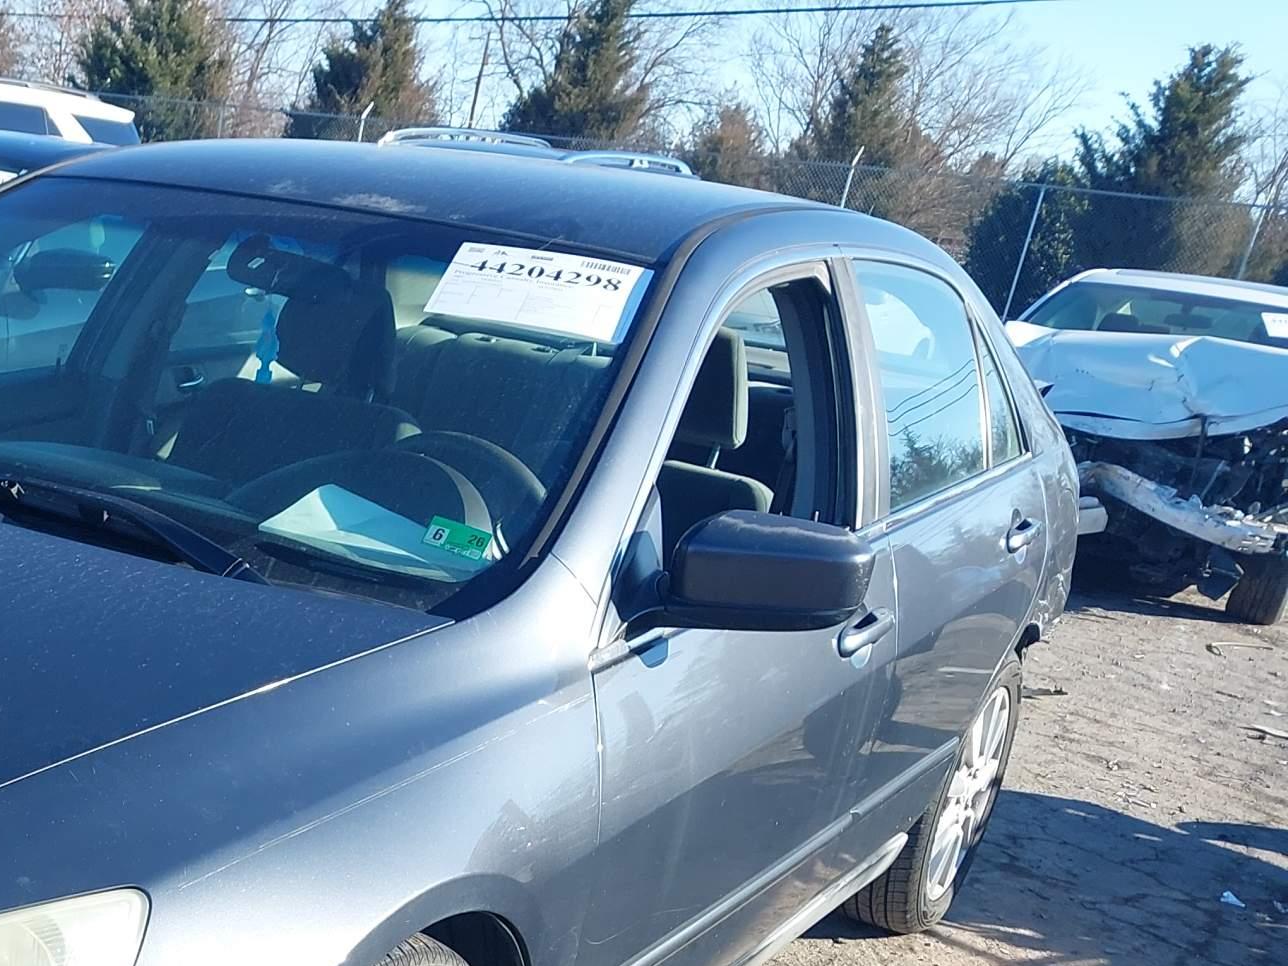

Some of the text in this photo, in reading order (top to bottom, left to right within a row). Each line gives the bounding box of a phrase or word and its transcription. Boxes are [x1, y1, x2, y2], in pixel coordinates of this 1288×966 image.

[470, 259, 623, 292] 44204298
[432, 528, 485, 548] 6 26
